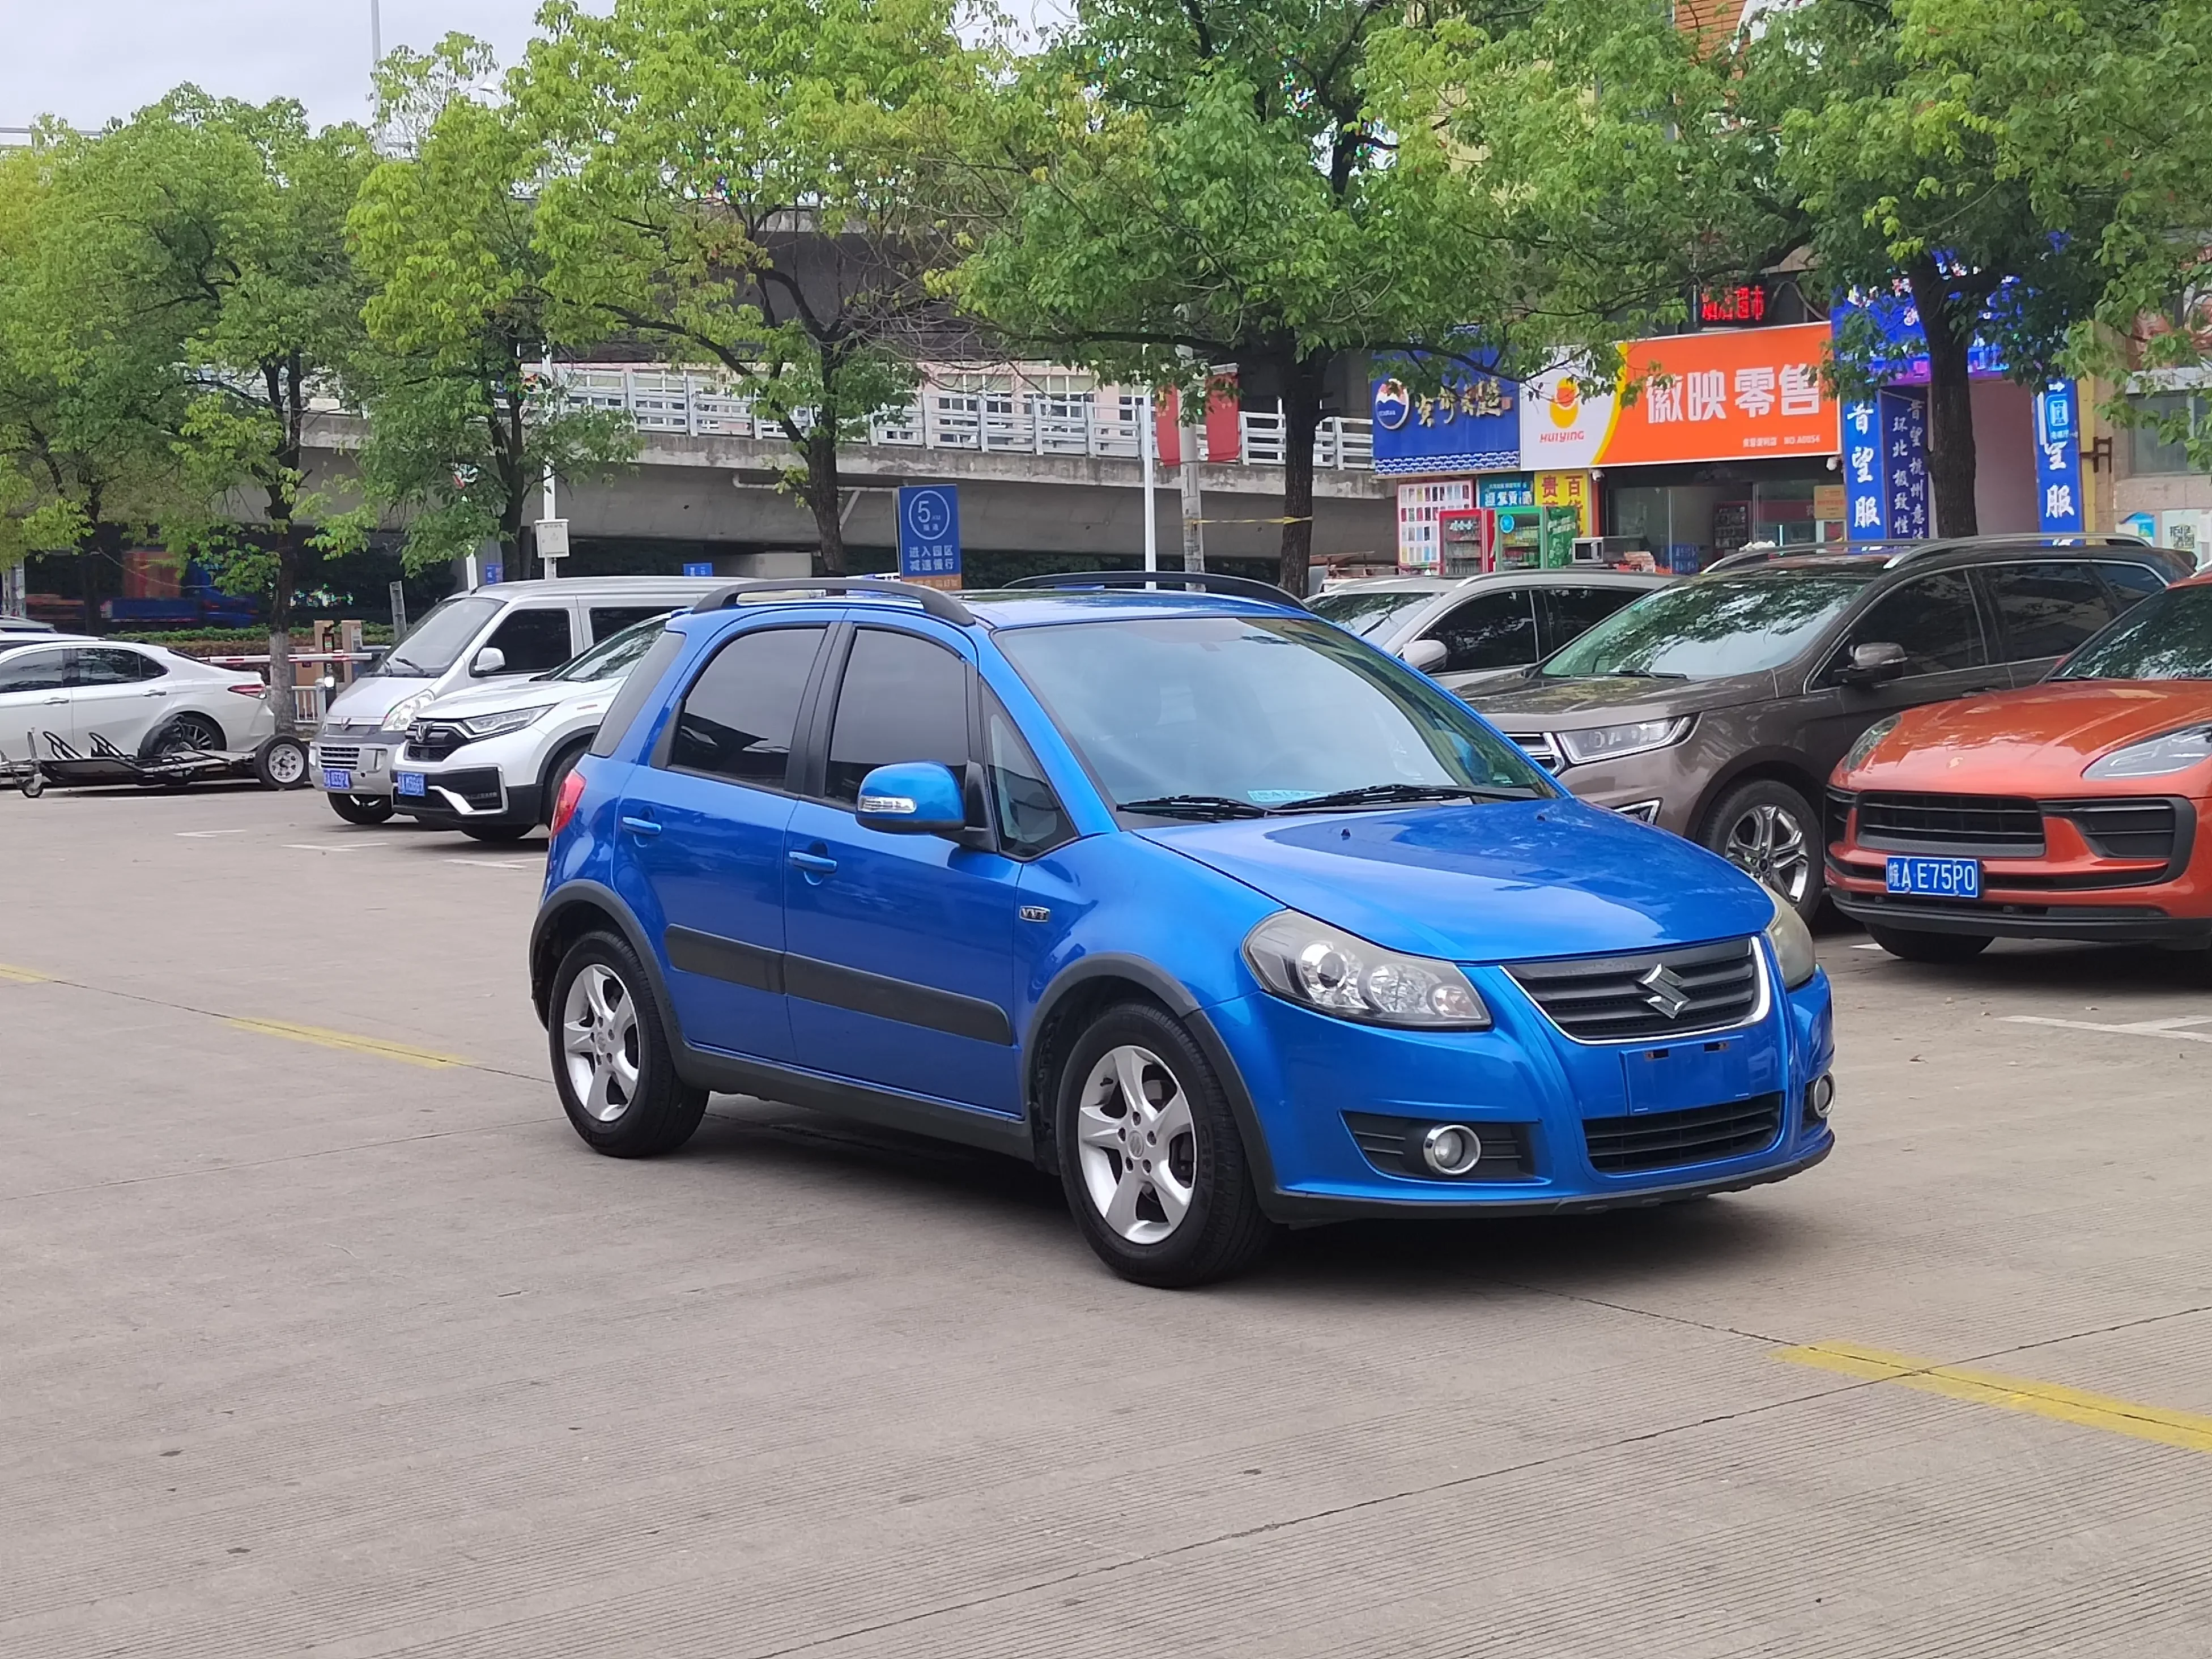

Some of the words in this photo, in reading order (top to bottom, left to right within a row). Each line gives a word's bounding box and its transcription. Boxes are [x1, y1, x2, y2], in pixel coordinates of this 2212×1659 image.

[1646, 364, 1819, 423] 徽映零售
[1539, 431, 1585, 443] HUIYING
[918, 501, 931, 523] 5
[909, 545, 954, 558] 进入园区
[909, 558, 954, 571] 减速慢行
